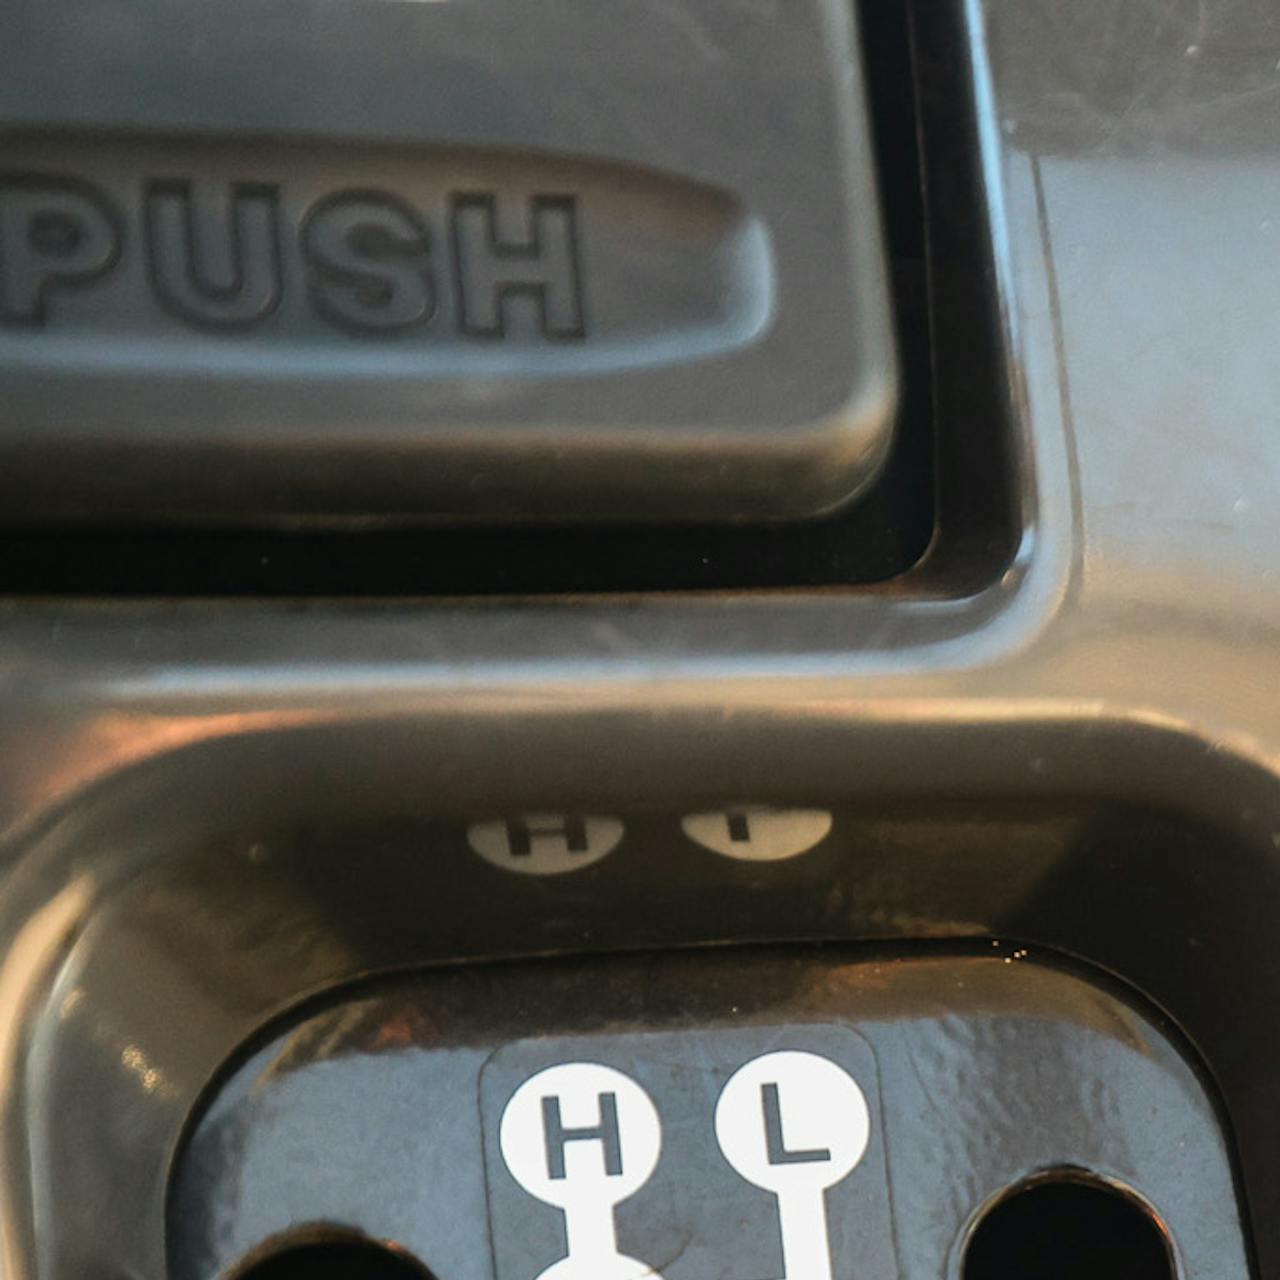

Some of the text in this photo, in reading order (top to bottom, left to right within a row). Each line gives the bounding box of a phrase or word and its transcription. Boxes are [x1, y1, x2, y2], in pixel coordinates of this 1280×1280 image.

[0, 170, 587, 343] PUSH
[540, 1091, 624, 1180] H
[760, 1081, 832, 1166] L
